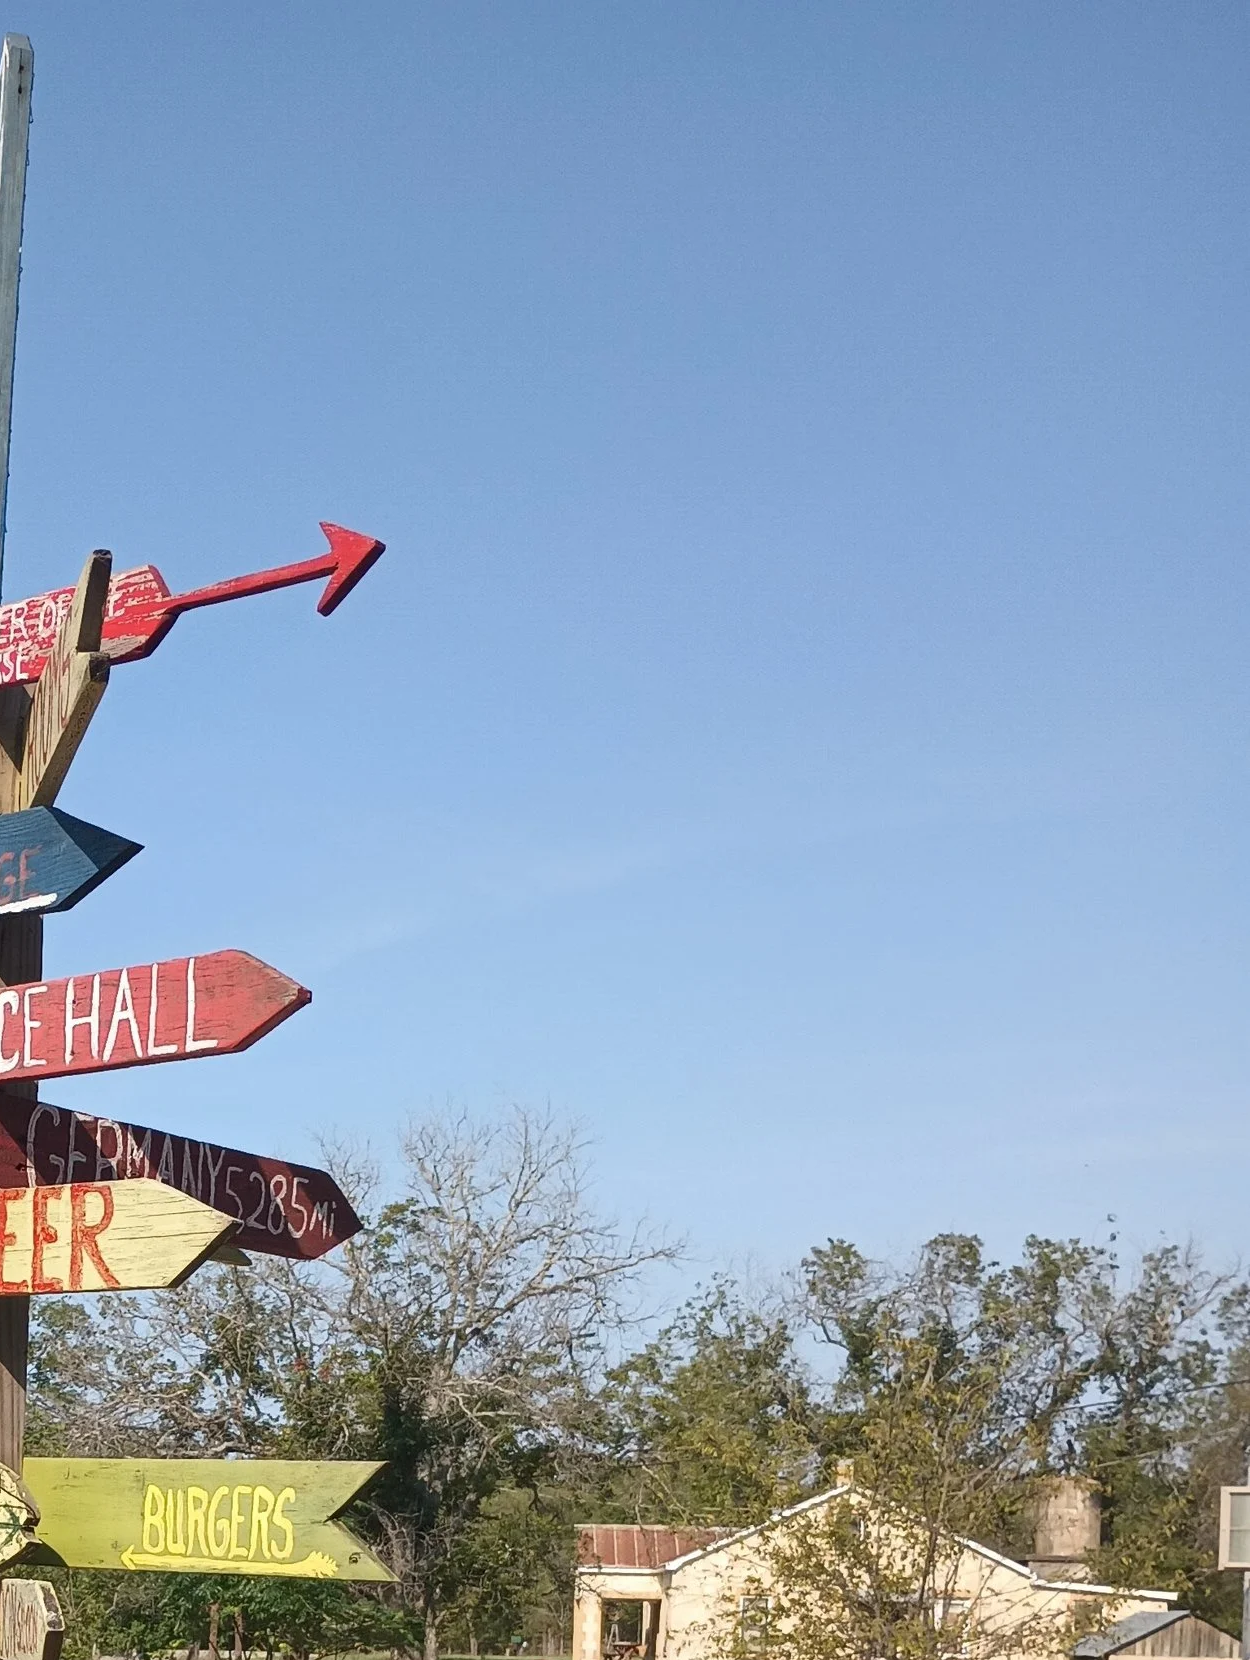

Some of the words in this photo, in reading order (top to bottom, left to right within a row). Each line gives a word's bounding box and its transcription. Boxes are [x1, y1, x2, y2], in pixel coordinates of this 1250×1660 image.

[64, 957, 219, 1066] HALL
[26, 1103, 226, 1207] GERMANY
[142, 1484, 296, 1560] BURGERS
